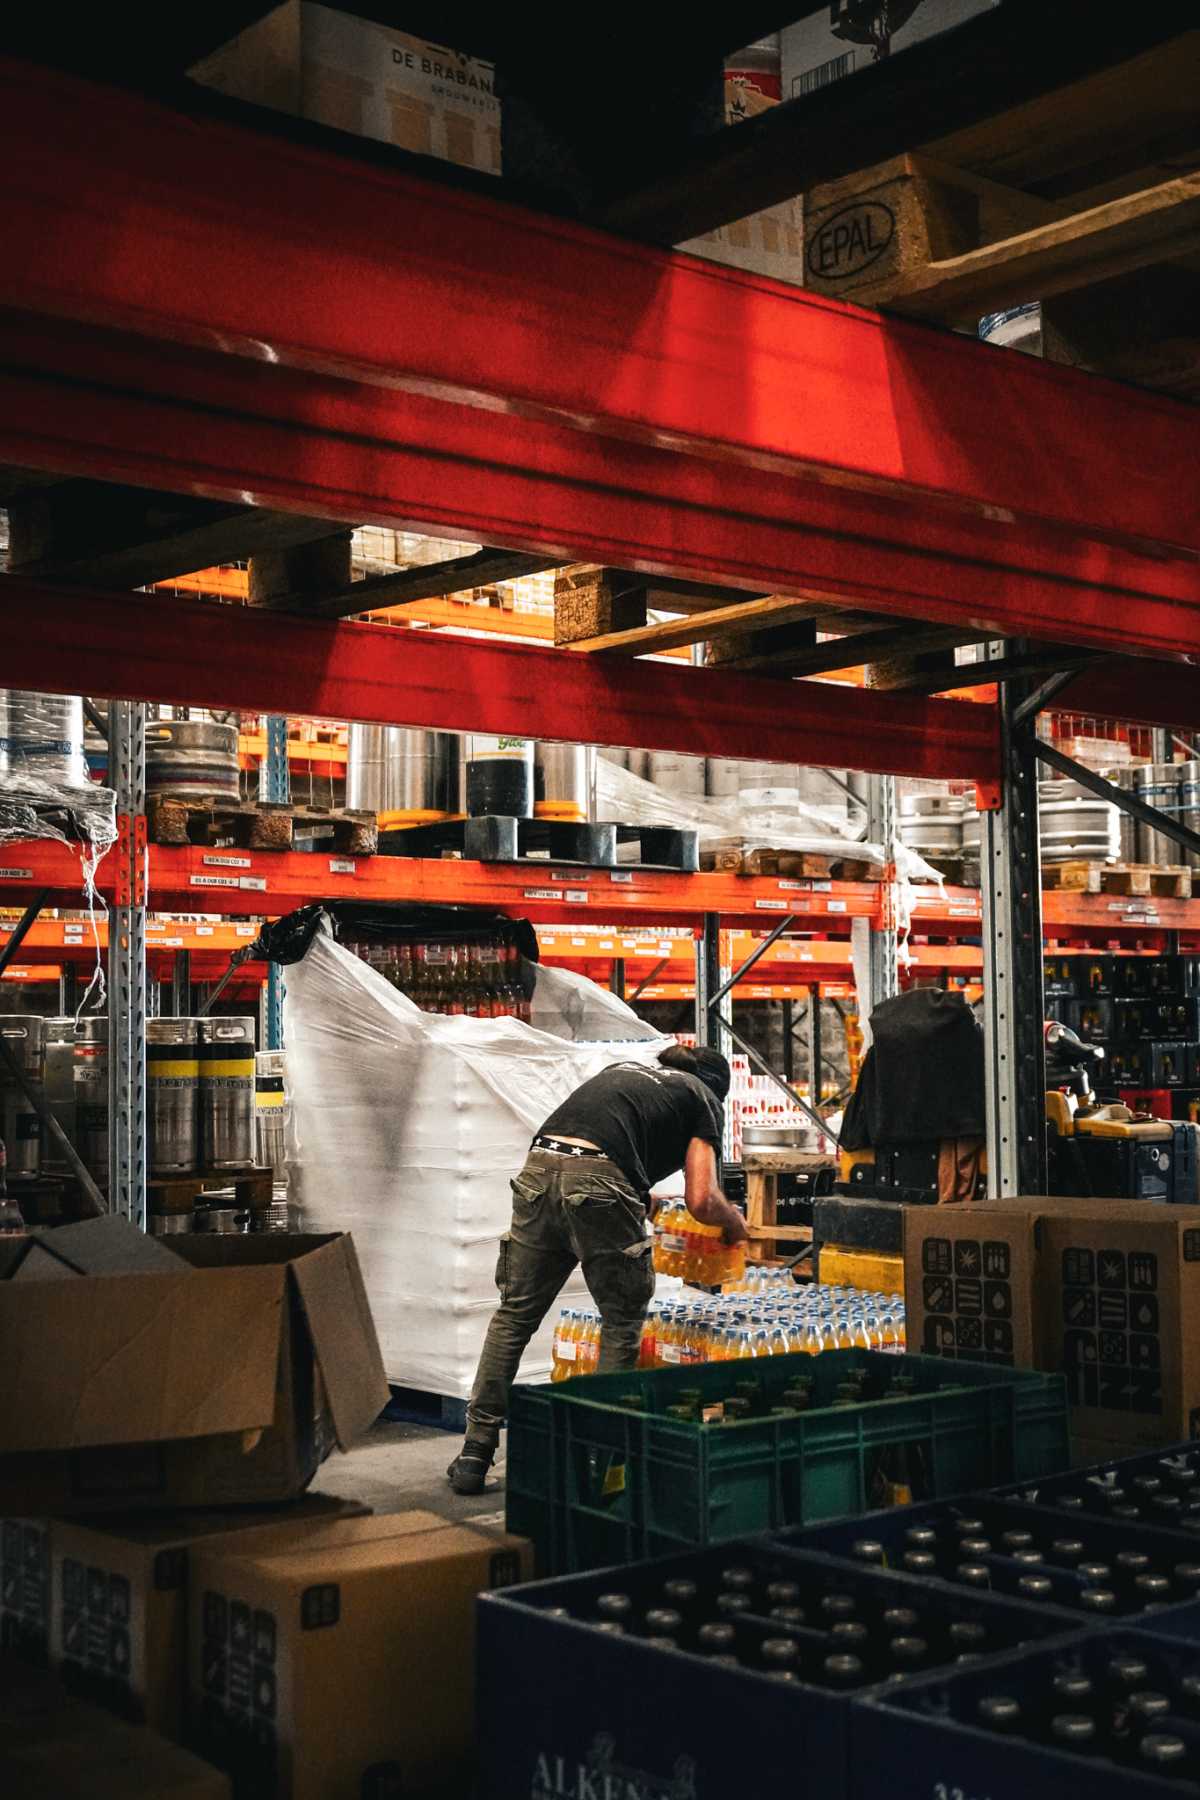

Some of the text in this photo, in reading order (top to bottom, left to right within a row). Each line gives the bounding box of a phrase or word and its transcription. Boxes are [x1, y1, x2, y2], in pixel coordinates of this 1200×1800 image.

[392, 49, 496, 95] DE BRABAN
[819, 214, 883, 272] EPAL
